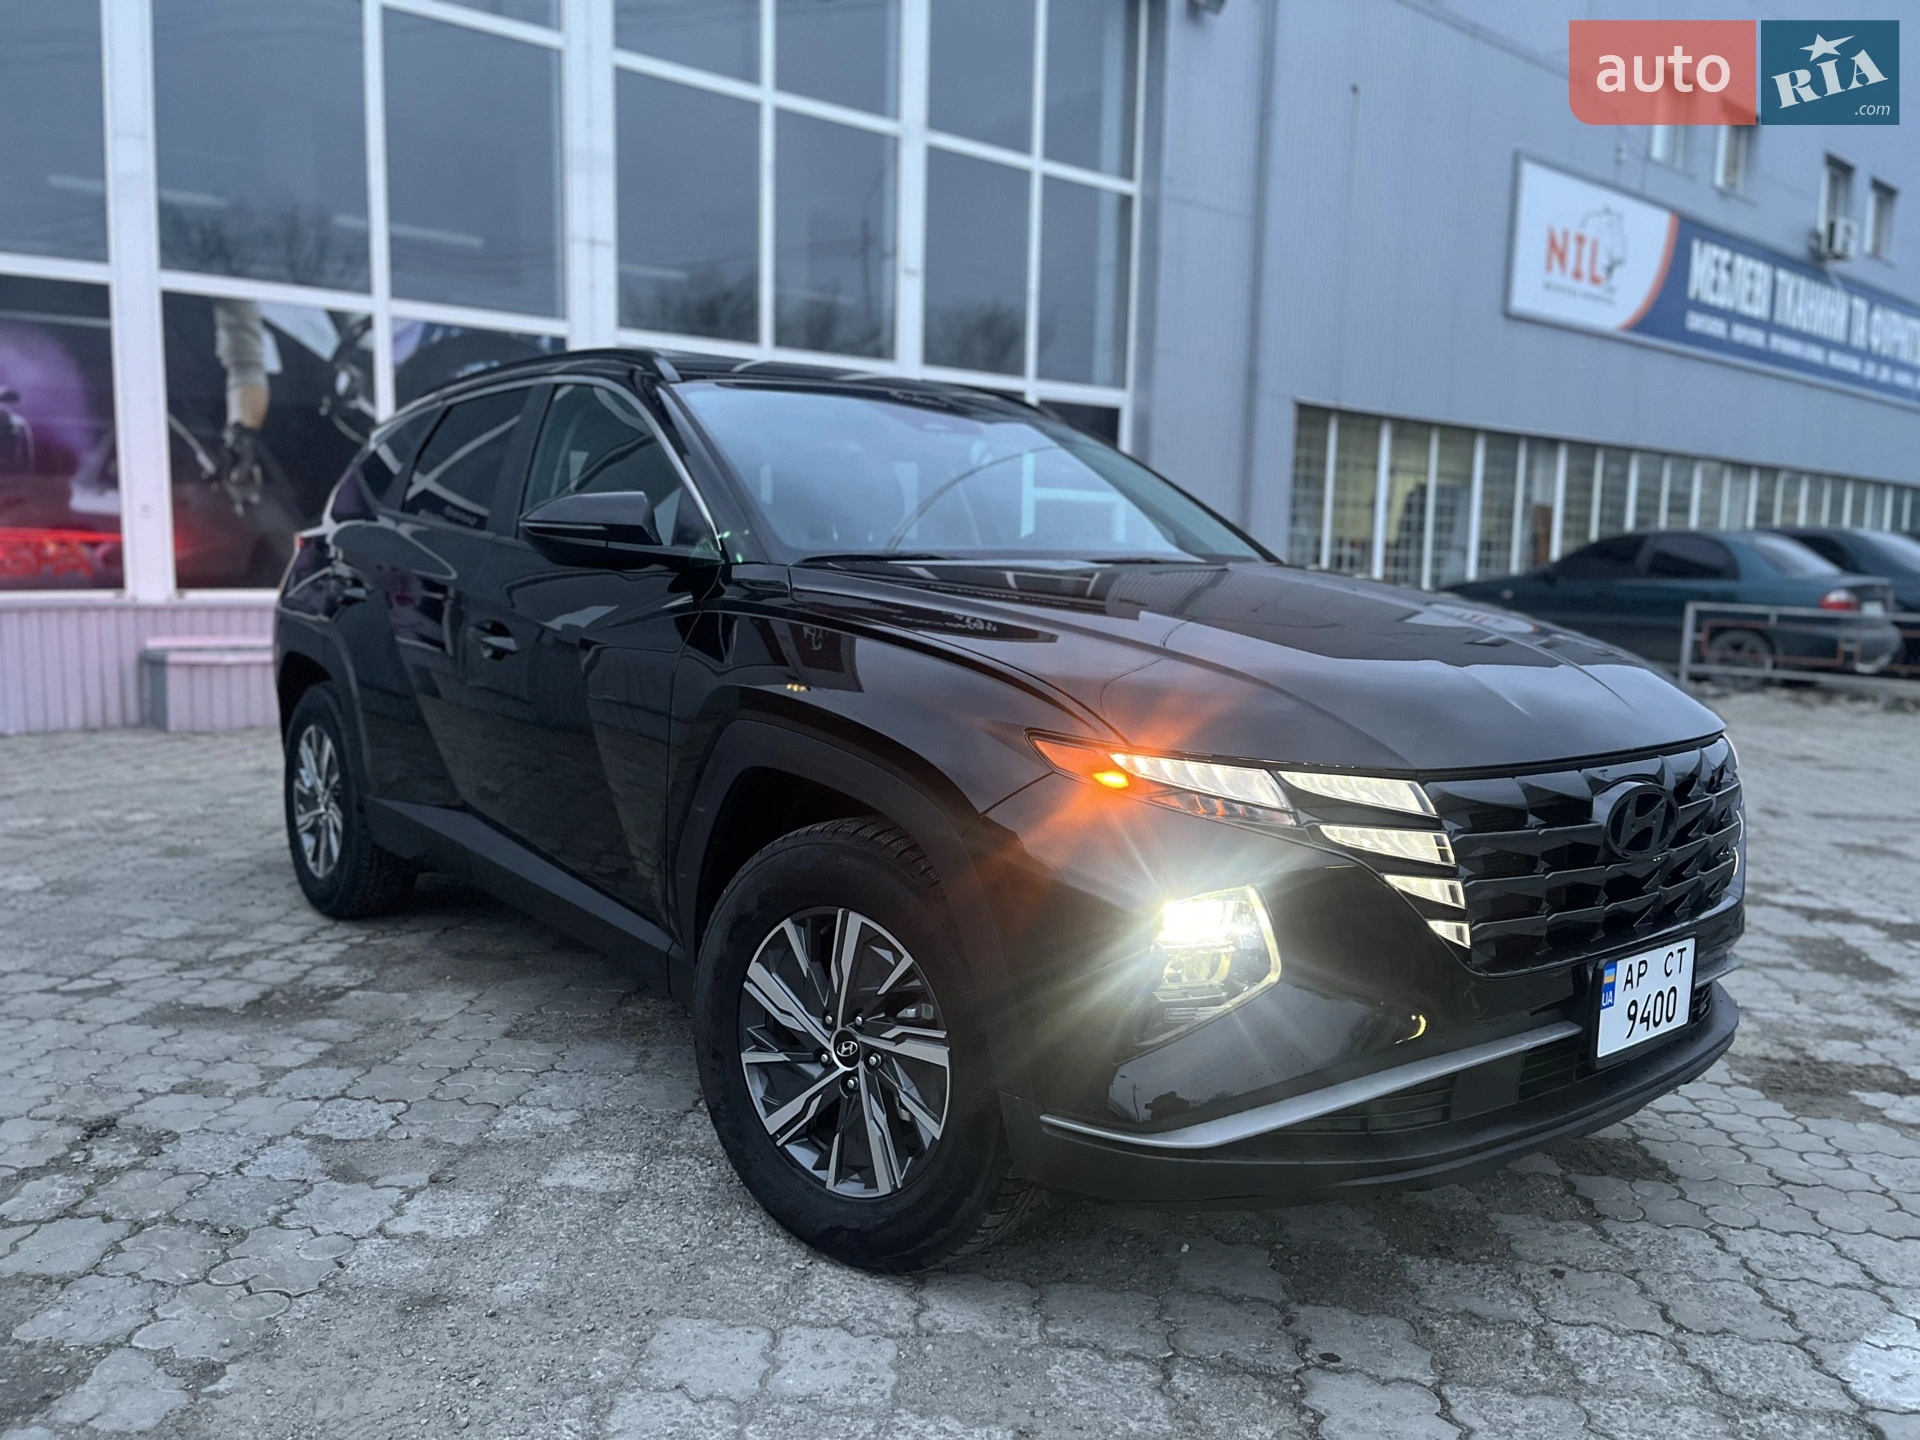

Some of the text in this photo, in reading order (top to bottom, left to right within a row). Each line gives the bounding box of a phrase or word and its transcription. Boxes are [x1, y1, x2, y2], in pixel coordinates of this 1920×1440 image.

[1544, 224, 1604, 287] NIL
[1850, 294, 1870, 351] ТА
[1623, 947, 1687, 992] AP CT
[1601, 990, 1614, 1007] UA
[1626, 985, 1678, 1040] 9400
